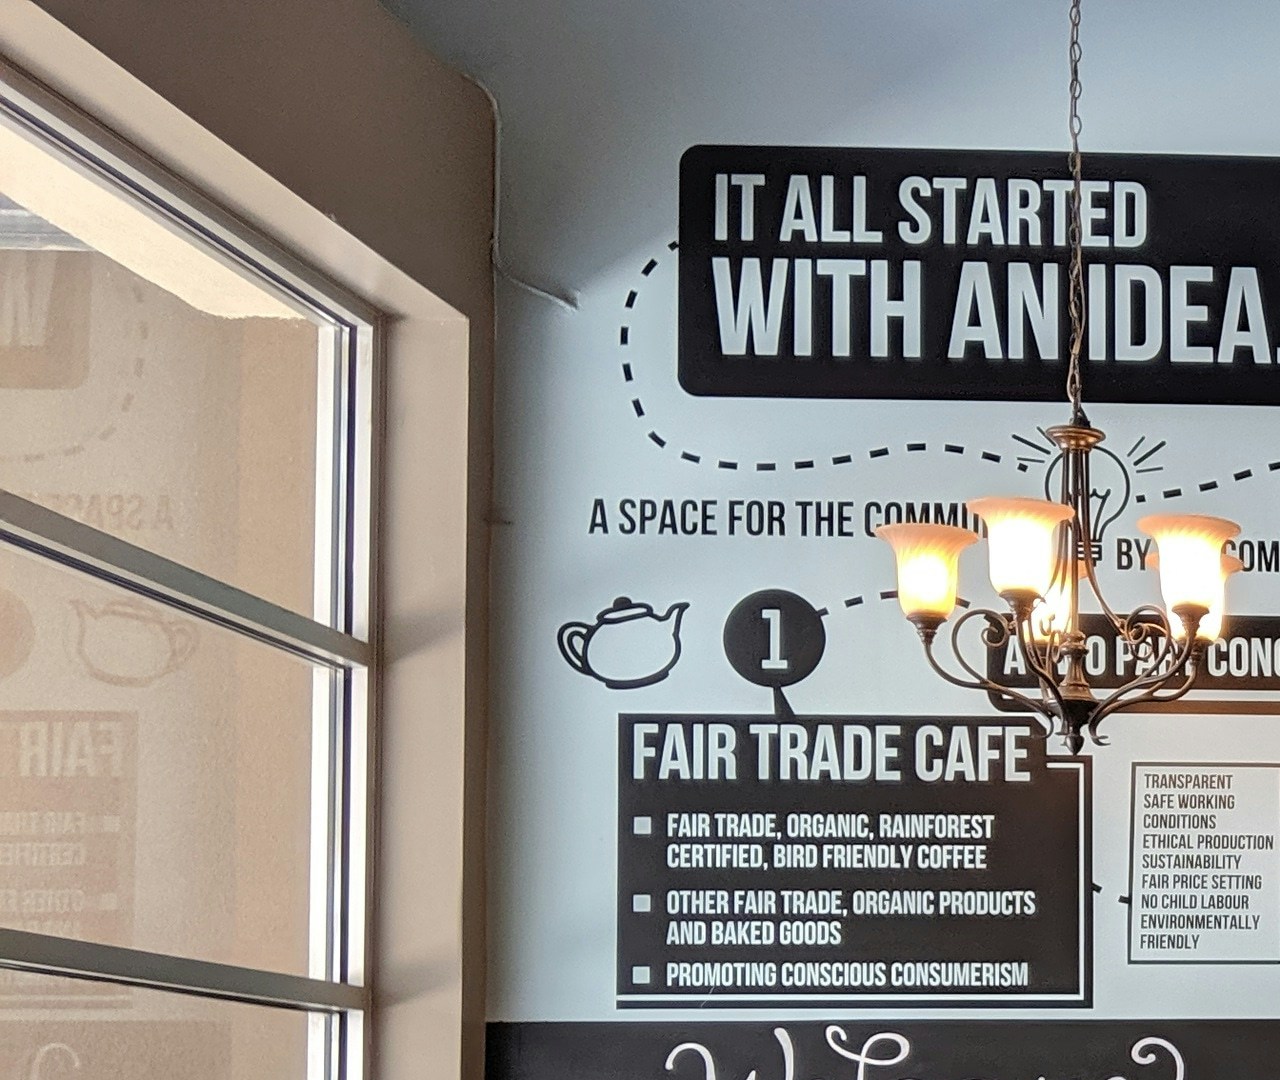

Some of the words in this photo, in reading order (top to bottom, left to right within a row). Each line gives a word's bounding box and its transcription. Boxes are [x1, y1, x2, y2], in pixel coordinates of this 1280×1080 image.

[715, 174, 765, 241] IT
[780, 175, 882, 242] ALL
[899, 177, 1147, 248] STARTED
[712, 258, 921, 357] WITH
[948, 262, 1058, 359] AN
[589, 499, 608, 534] A
[619, 499, 717, 535] SPACE
[729, 501, 785, 535] FOR
[795, 502, 853, 537] THE
[865, 502, 989, 538] COMMU
[1117, 539, 1151, 570] BY
[762, 610, 787, 669] 1
[1004, 639, 1024, 674] A
[634, 724, 736, 779] FAIR
[750, 725, 901, 780] TRADE
[916, 725, 1030, 781] CAFE
[1145, 774, 1233, 789] TRANSPARENT
[1144, 794, 1174, 808] SAFE
[1178, 794, 1234, 809] WORKING
[668, 814, 710, 837] FAIR
[715, 814, 781, 839] TRADE,
[787, 814, 873, 840] ORGANIC,
[880, 815, 994, 838] RAINFOREST
[1144, 814, 1216, 829] CONDITIONS
[1143, 834, 1193, 849] ETHICAL
[1198, 835, 1273, 849] PRODUCTION
[668, 844, 768, 870] CERTIFIED,
[774, 845, 817, 867] BIRD
[823, 845, 912, 868] FRIENDLY
[918, 845, 986, 868] COFFEE
[1143, 854, 1241, 869] SUSTAINABILITY
[1142, 874, 1169, 888] FAIR
[1173, 875, 1207, 889] PRICE
[1212, 875, 1261, 889] SETTING
[668, 891, 728, 914] OTHER
[734, 891, 776, 914] FAIR
[781, 891, 847, 916] TRADE,
[853, 891, 934, 914] ORGANIC
[940, 891, 1035, 915] PRODUCTS
[1142, 894, 1157, 908] NO
[1162, 894, 1197, 909] CHILD
[1201, 895, 1248, 909] LABOUR
[667, 921, 706, 944] AND
[712, 921, 774, 944] BAKED
[780, 921, 841, 944] GOODS
[1141, 914, 1259, 929] ENVIRONMENTALLY
[1141, 934, 1199, 949] FRIENDLY
[667, 963, 776, 986] PROMOTING
[782, 963, 886, 986] CONSCIOUS
[891, 963, 1028, 986] CONSUMERISM
